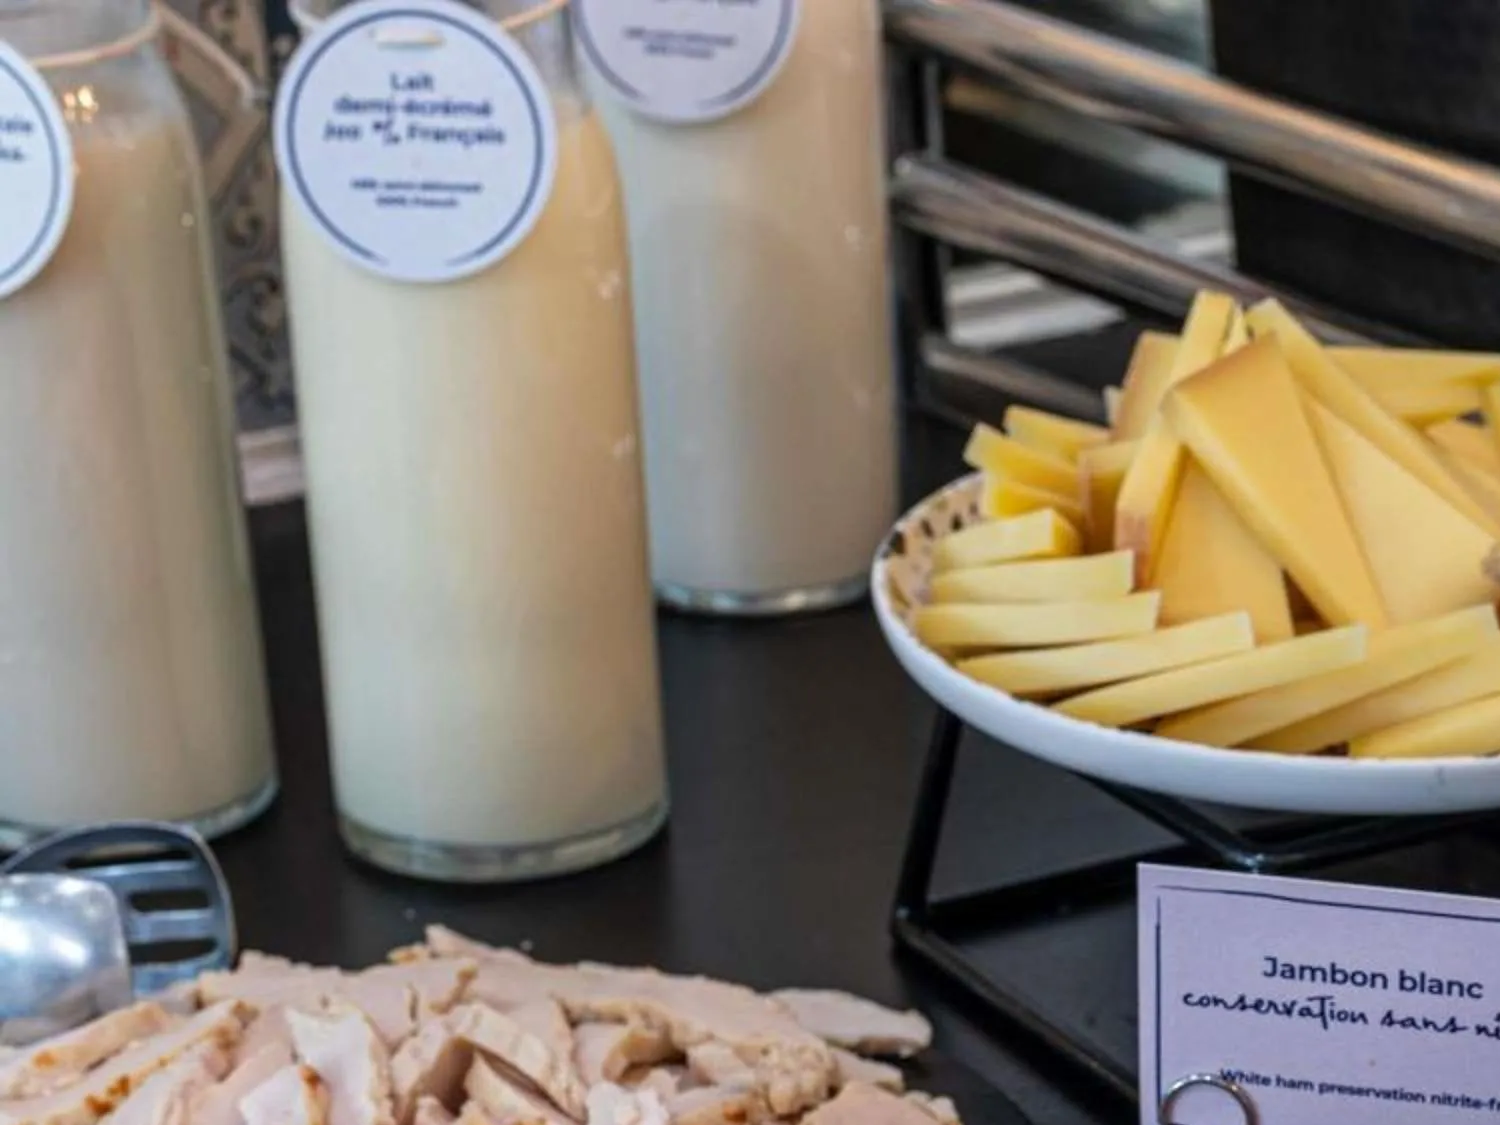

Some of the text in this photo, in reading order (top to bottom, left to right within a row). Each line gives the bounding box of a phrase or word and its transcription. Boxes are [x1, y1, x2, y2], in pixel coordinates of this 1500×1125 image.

[390, 72, 434, 92] Lait
[406, 122, 505, 148] Français
[1263, 957, 1484, 1000] Jambon blanc
[1183, 989, 1369, 1030] conservation
[1380, 1008, 1469, 1032] sans
[1220, 1067, 1271, 1087] White
[1275, 1074, 1314, 1091] ham
[1318, 1081, 1427, 1104] preservation
